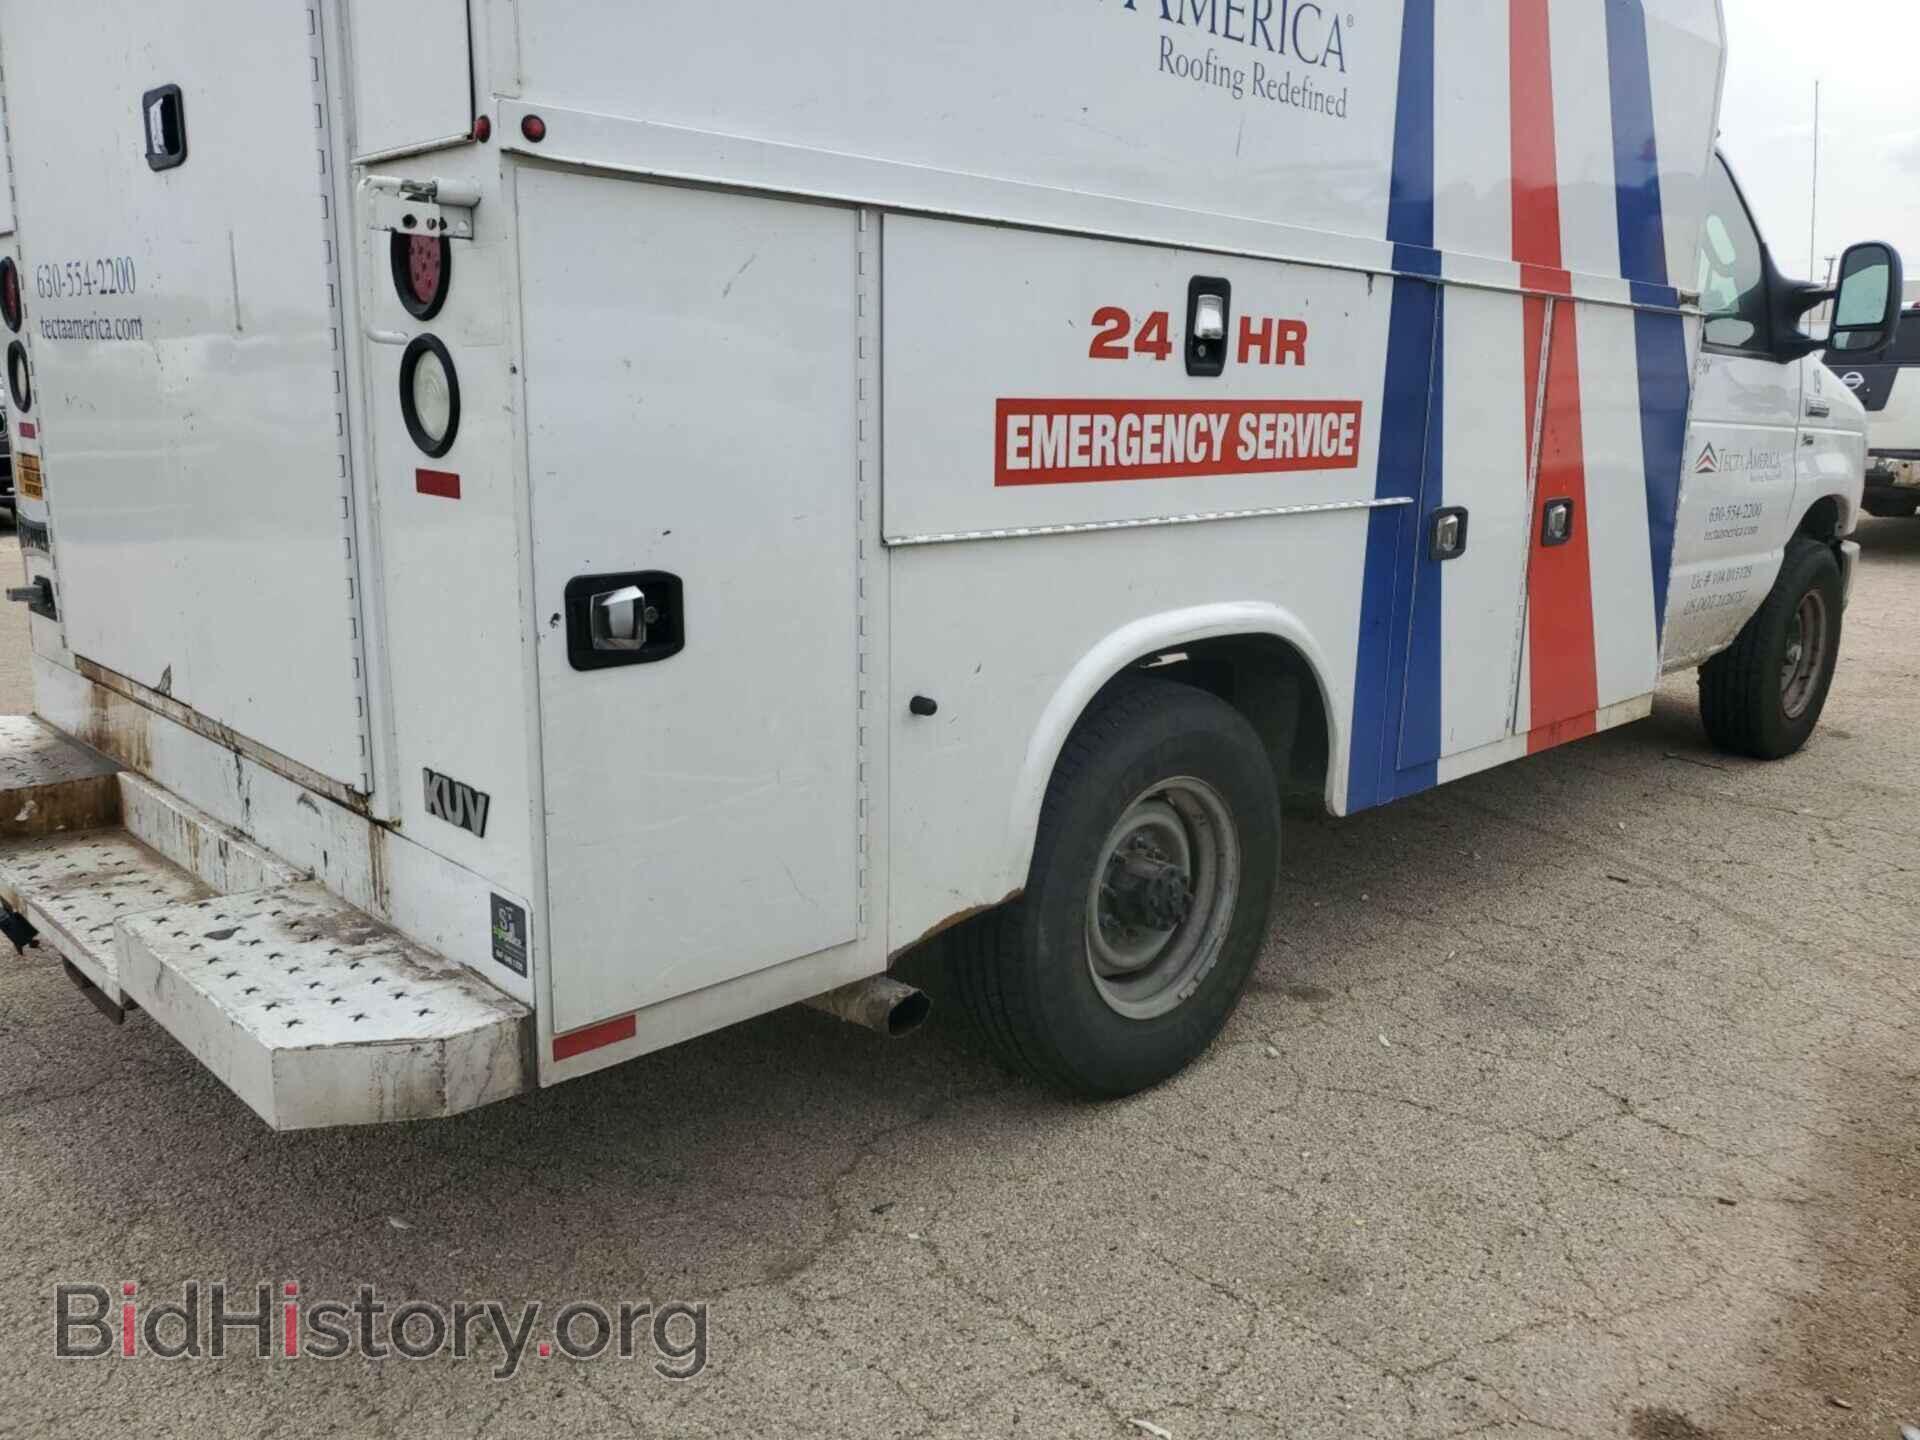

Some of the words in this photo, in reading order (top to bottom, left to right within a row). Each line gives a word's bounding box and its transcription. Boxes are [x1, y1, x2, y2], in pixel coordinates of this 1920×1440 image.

[1159, 34, 1246, 100] Roofing
[1252, 61, 1348, 119] Redefined
[36, 256, 136, 298] 630-554-2200
[40, 312, 144, 341] tectaamerica.com
[1089, 306, 1173, 361] 24
[1236, 315, 1308, 366] HR
[1005, 413, 1230, 471] EMERGENCY
[1236, 412, 1356, 462] SERVICE
[422, 766, 490, 839] KUV
